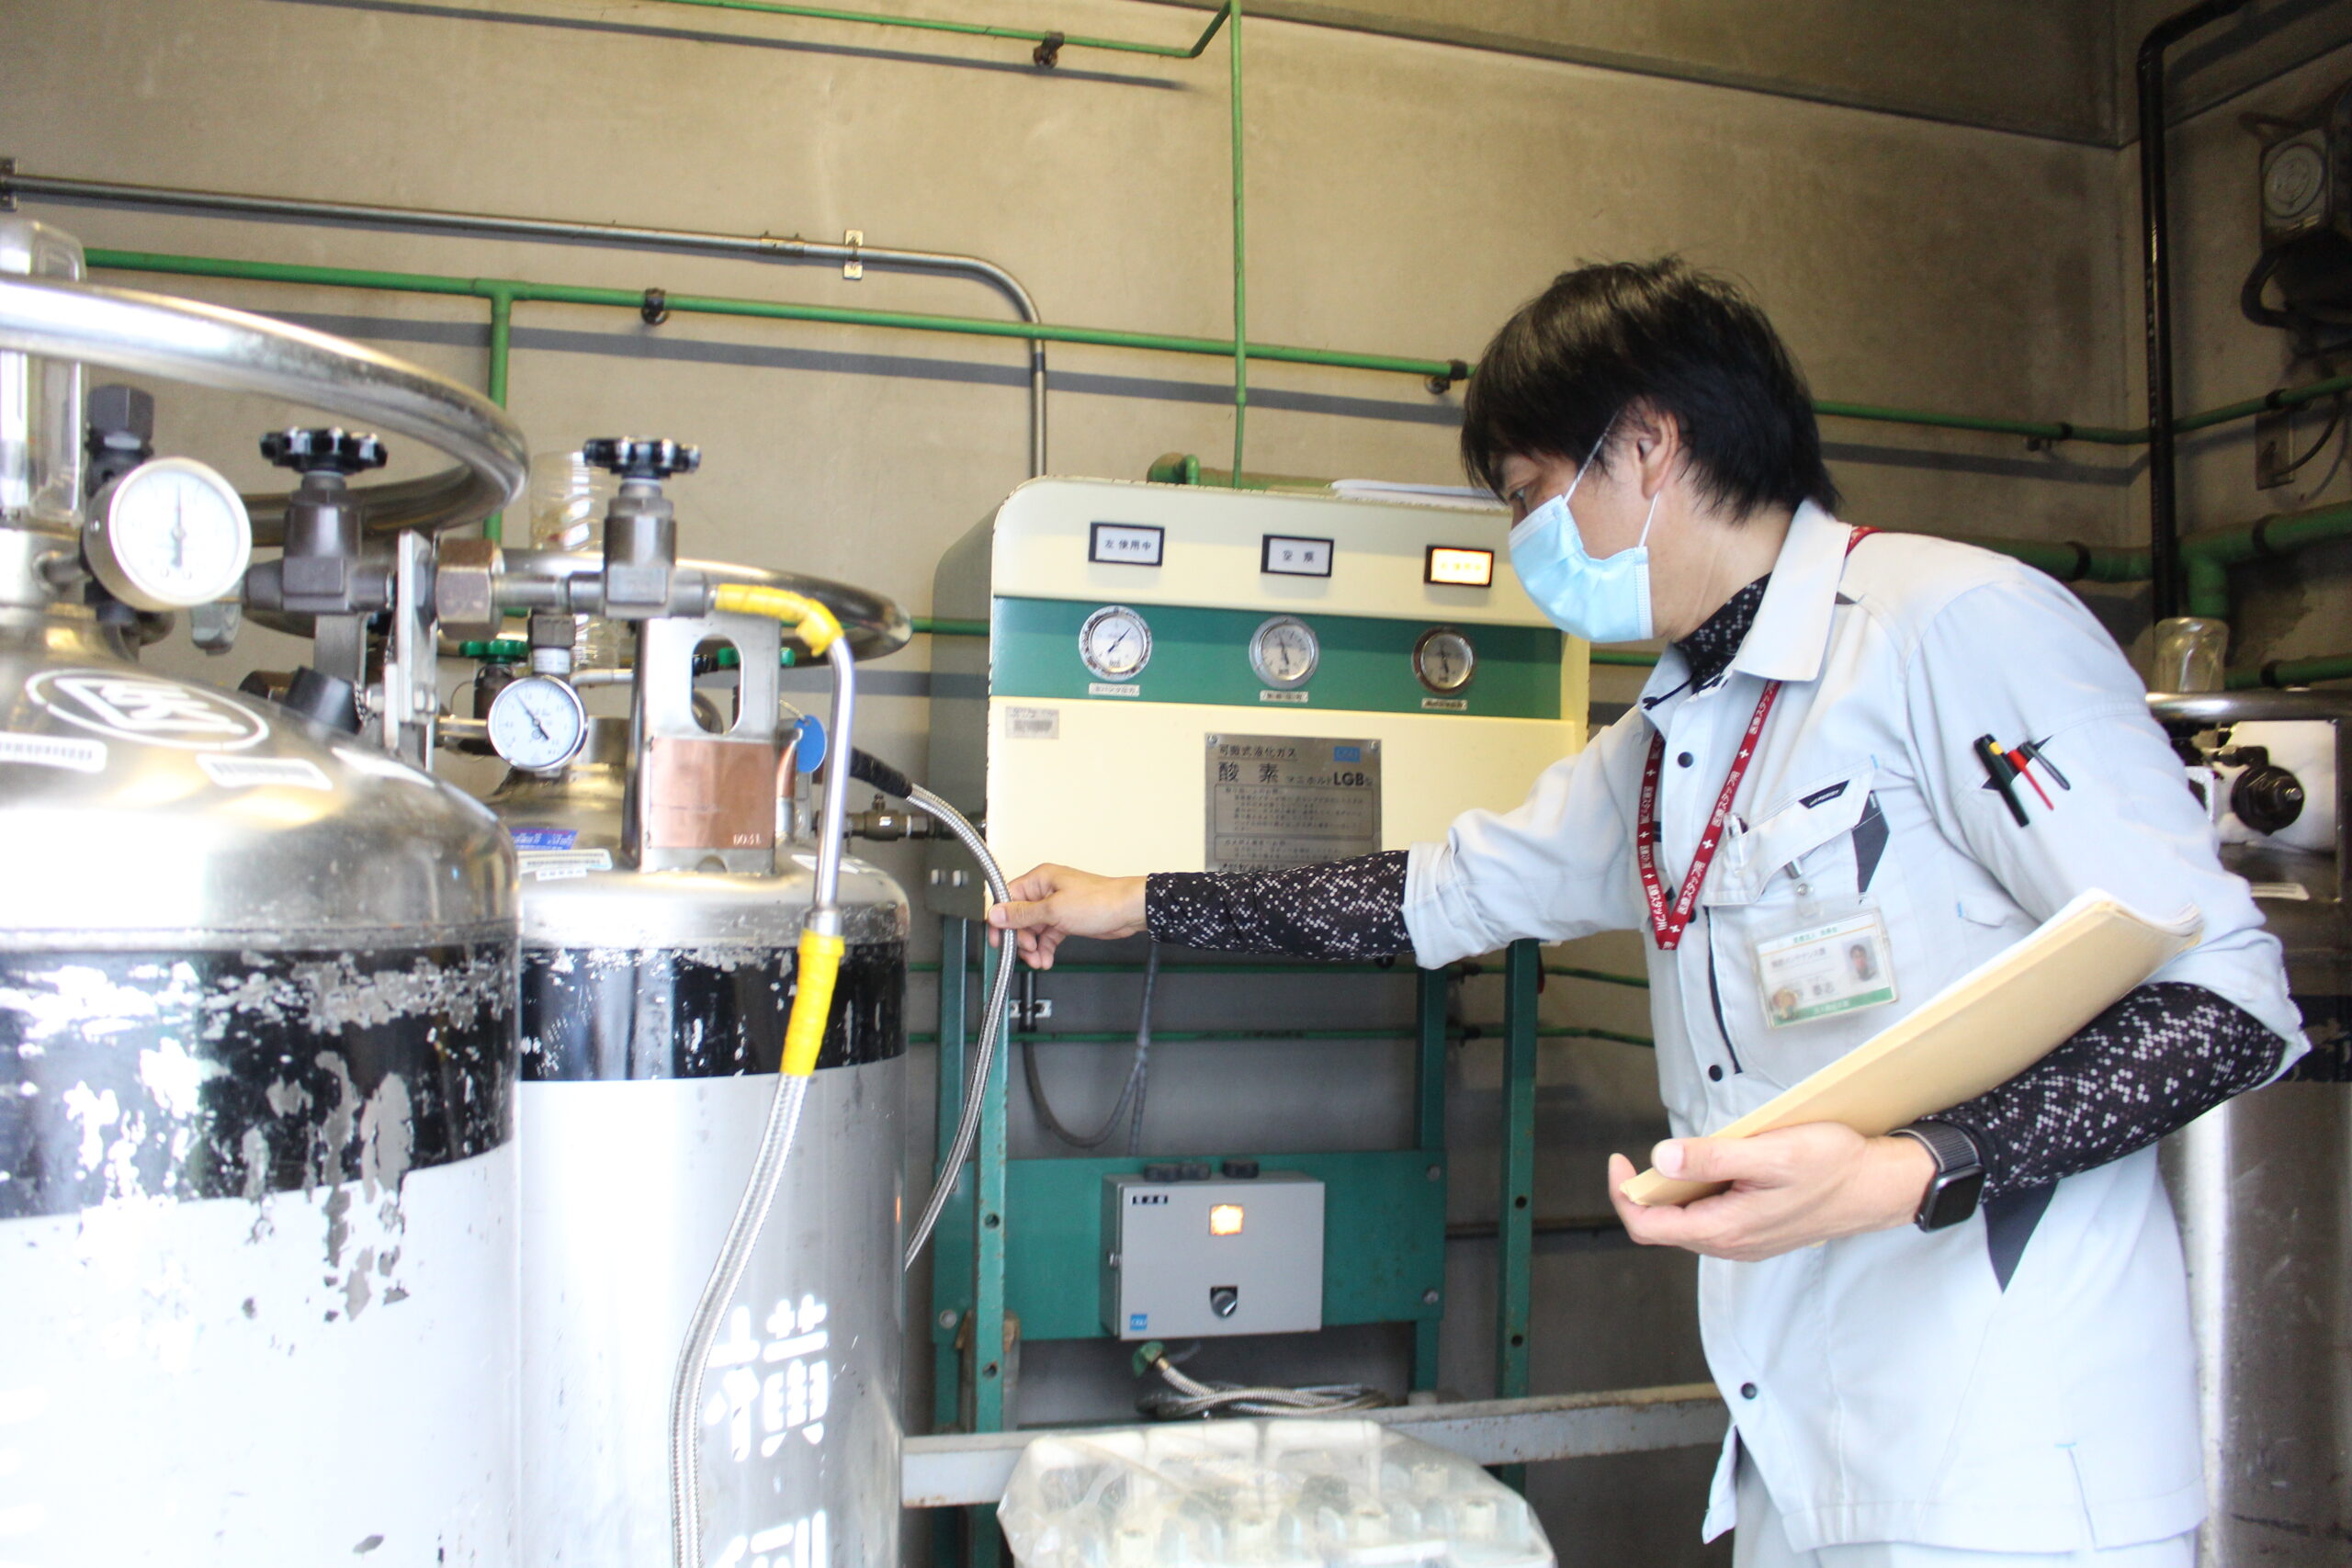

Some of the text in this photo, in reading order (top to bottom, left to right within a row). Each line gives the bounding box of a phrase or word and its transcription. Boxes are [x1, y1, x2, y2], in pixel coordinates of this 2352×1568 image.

[1677, 860, 1706, 916] 医療スタッフ用
